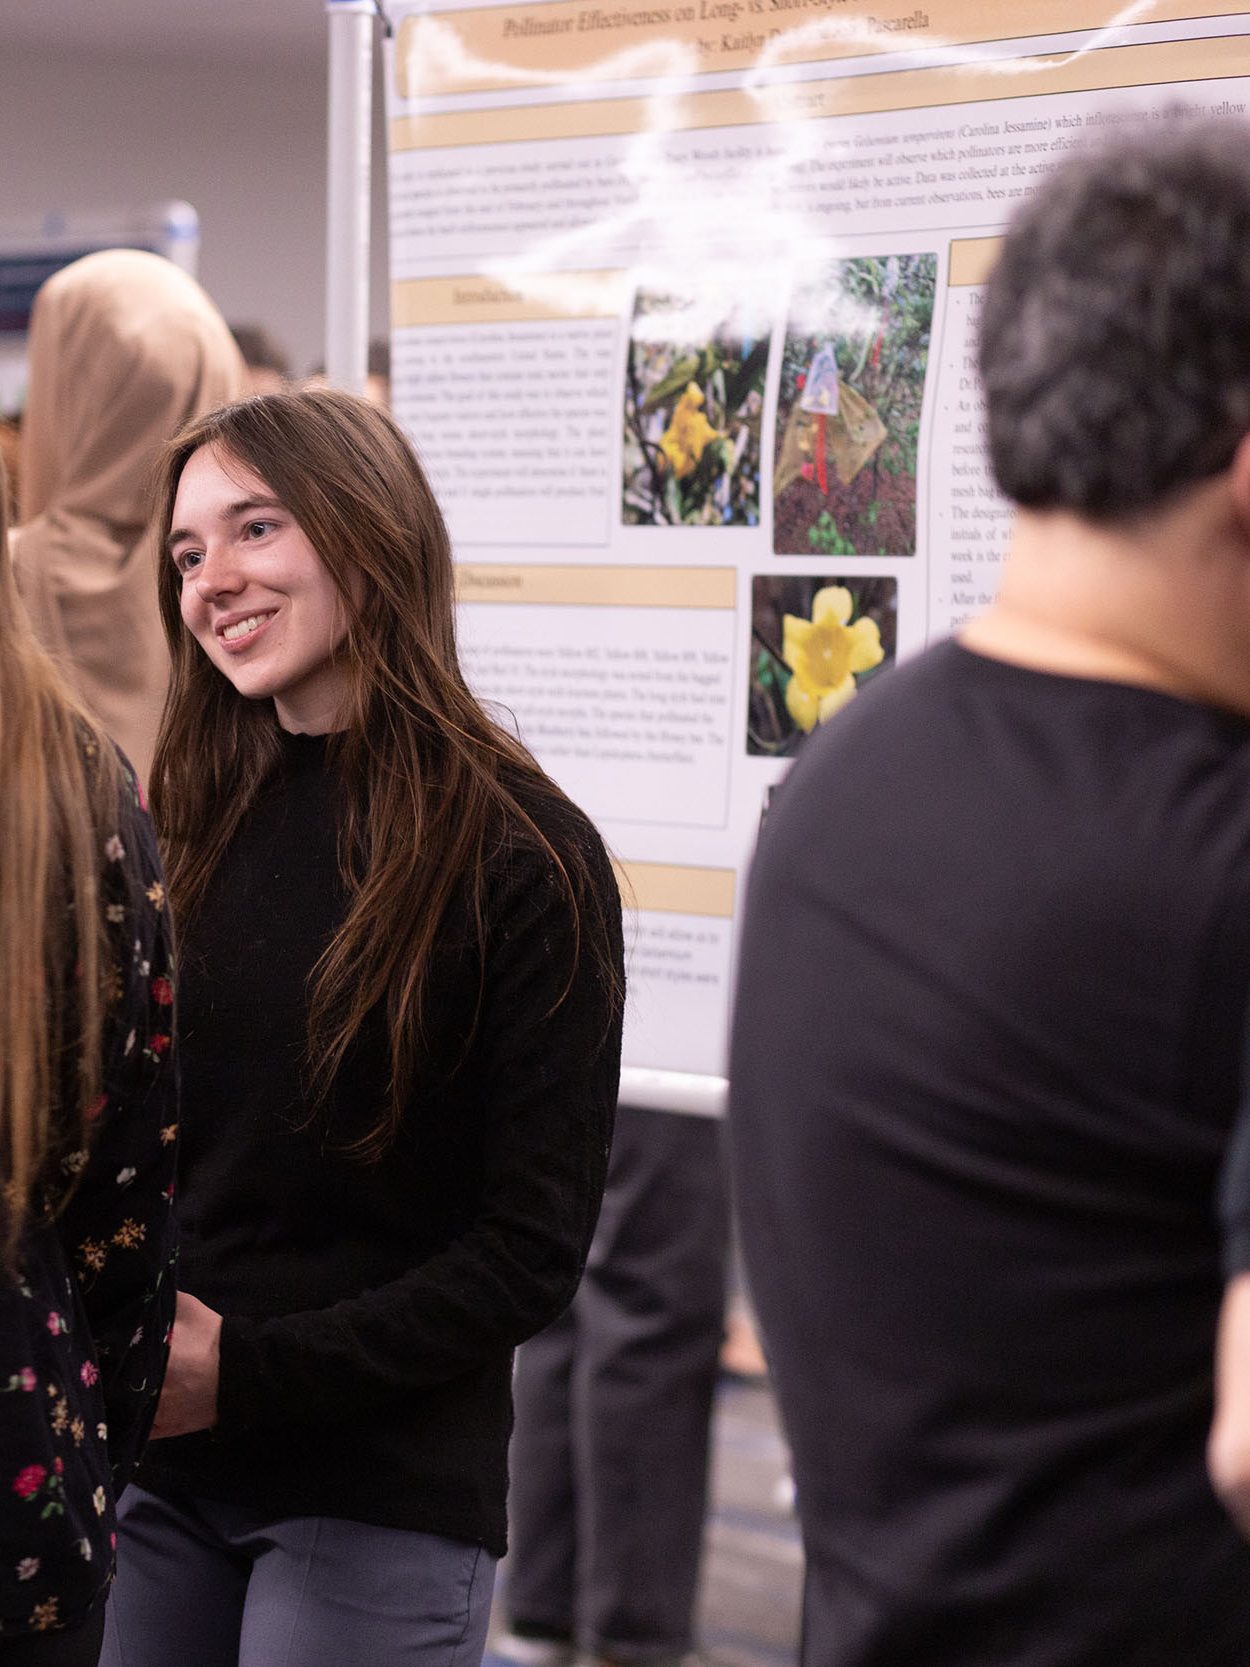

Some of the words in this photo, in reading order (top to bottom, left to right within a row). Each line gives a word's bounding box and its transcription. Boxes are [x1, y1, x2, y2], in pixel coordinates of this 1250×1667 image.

[503, 16, 574, 38] Pollinator
[577, 9, 671, 32] Effectiveness
[675, 7, 695, 22] on
[867, 10, 930, 33] Pascarella
[958, 122, 999, 138] (Carolina
[1003, 117, 1051, 134] Jessamine)
[1055, 113, 1082, 128] which
[1151, 107, 1159, 120] is
[1210, 101, 1246, 116] yellow
[895, 152, 928, 165] observe
[931, 147, 955, 161] which
[958, 145, 1005, 163] pollinators
[1007, 145, 1022, 154] are
[1024, 142, 1048, 153] more
[915, 170, 937, 184] Data
[940, 172, 956, 181] was
[958, 165, 997, 180] collected
[999, 166, 1009, 177] at
[1011, 162, 1026, 176] the
[871, 195, 892, 209] from
[986, 188, 1006, 200] bees
[1008, 188, 1022, 198] are
[951, 505, 969, 519] The
[950, 548, 973, 562] week
[986, 548, 1000, 562] the
